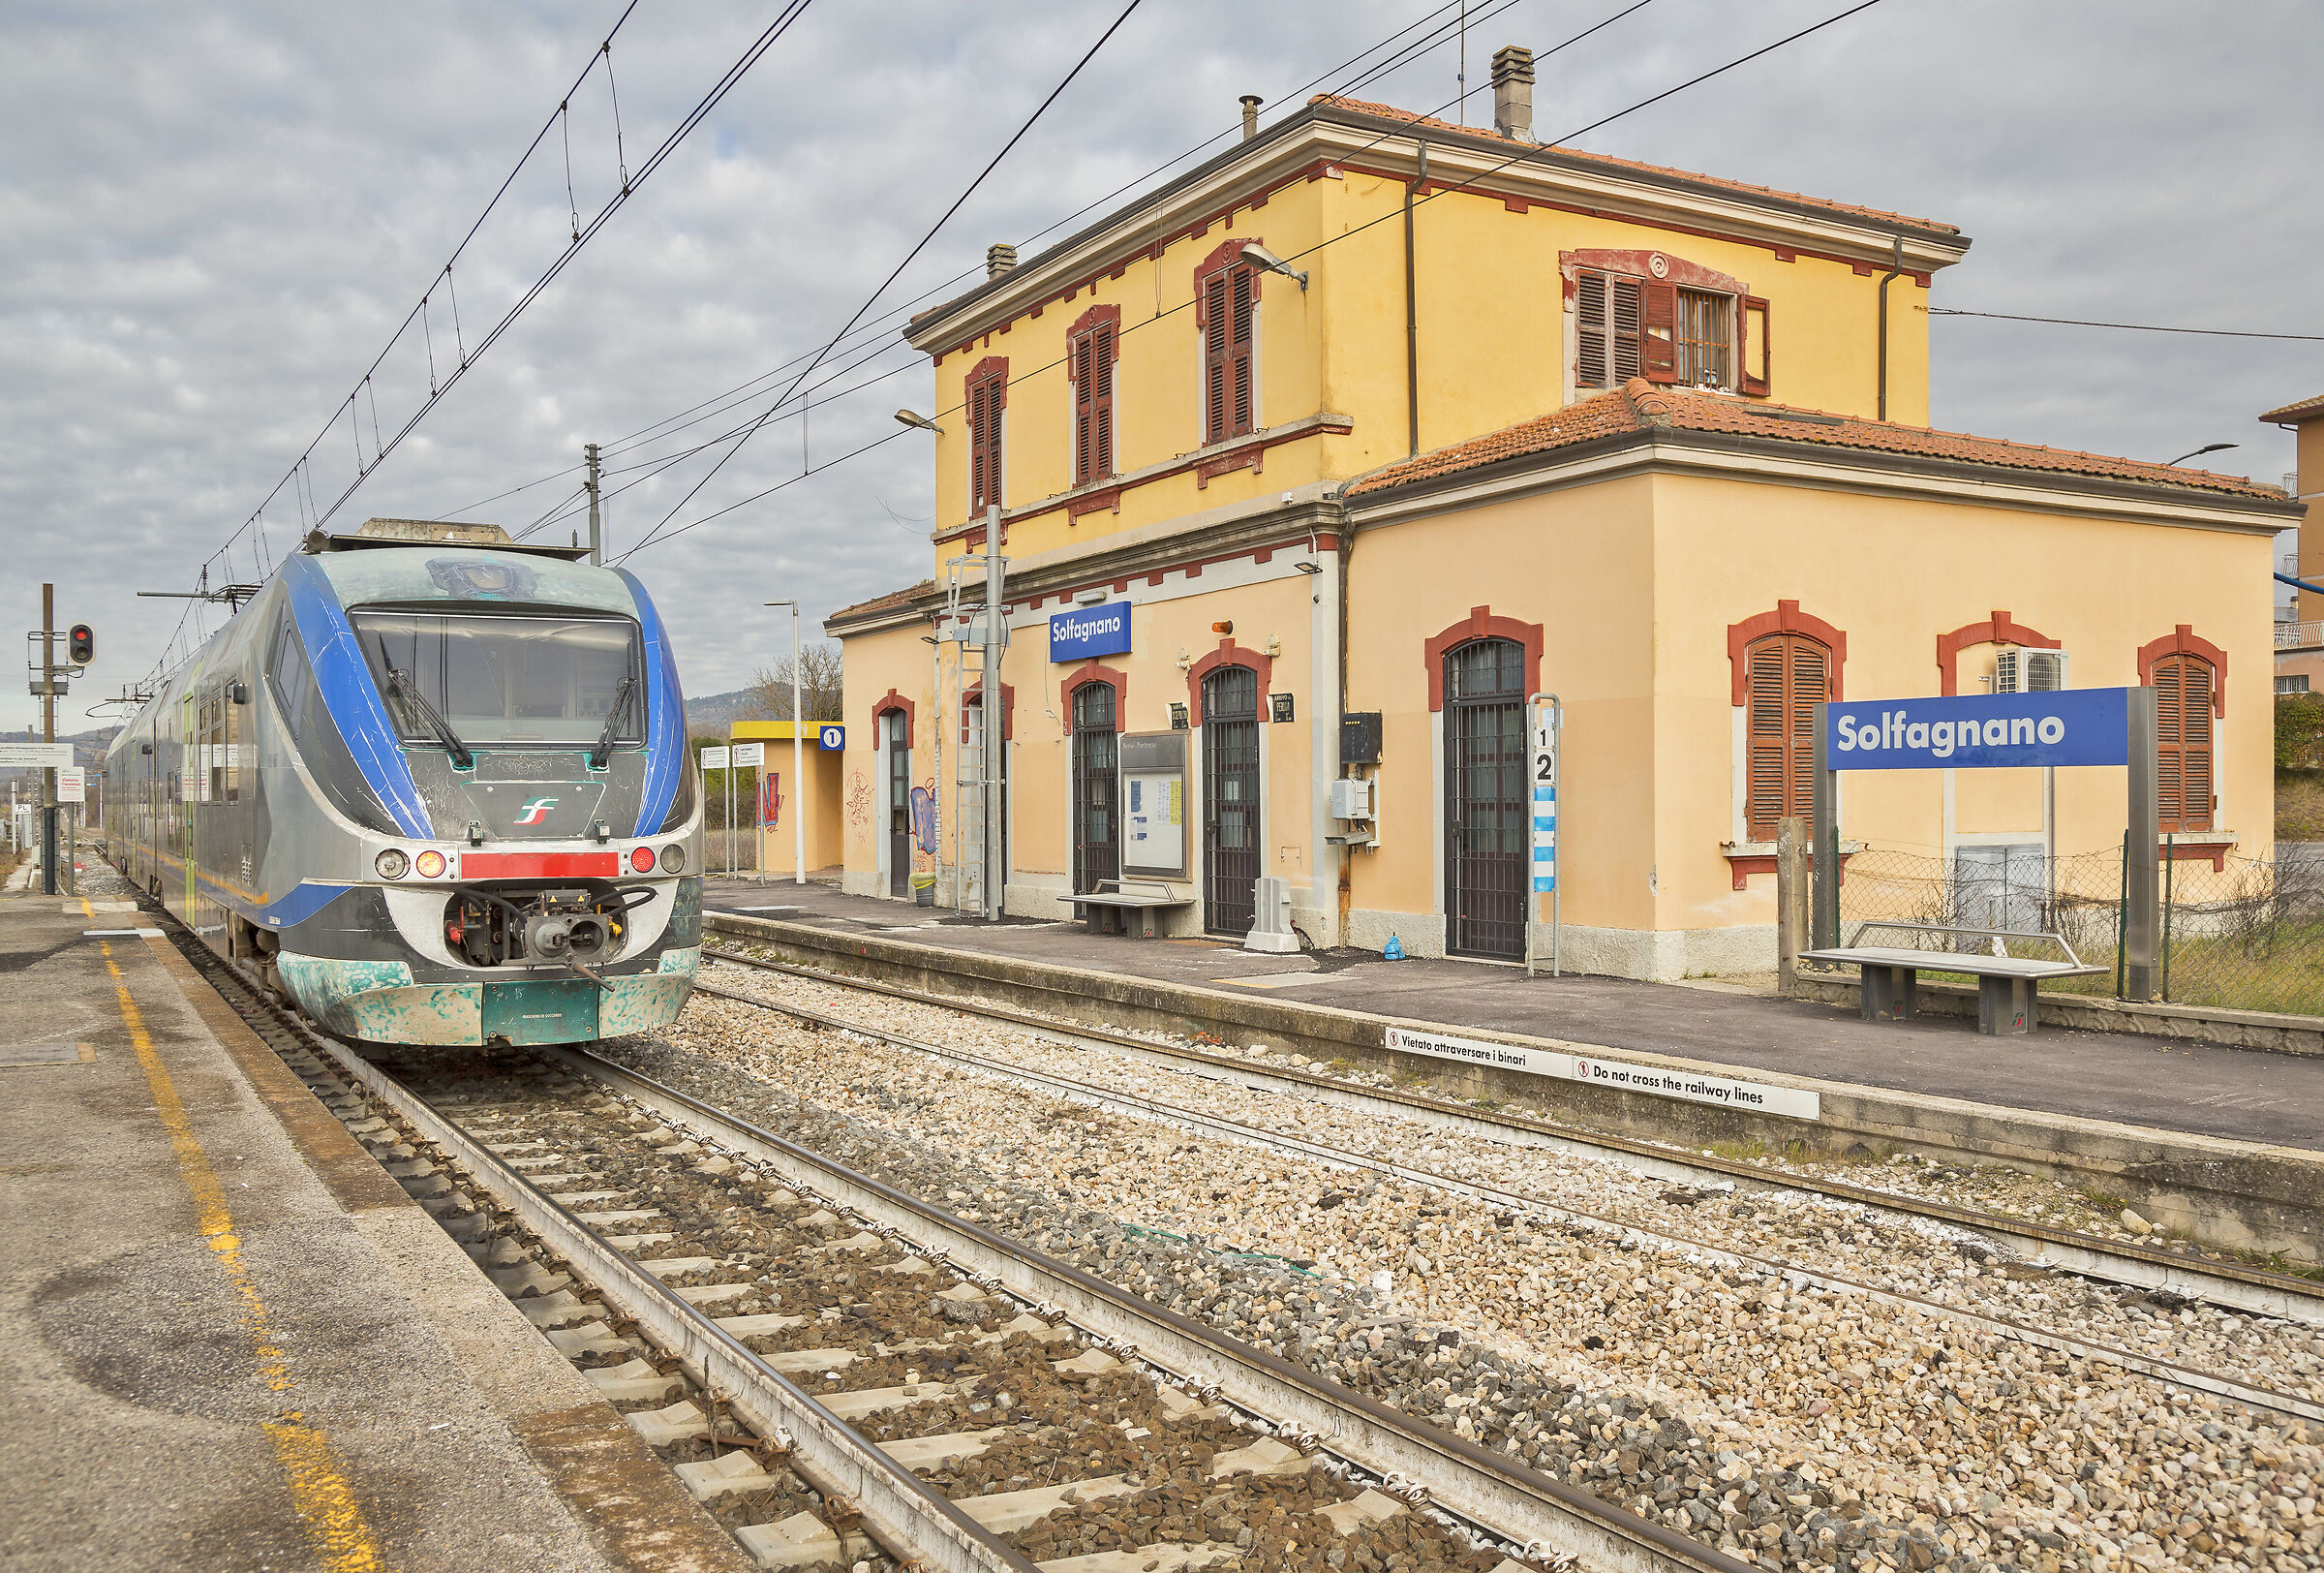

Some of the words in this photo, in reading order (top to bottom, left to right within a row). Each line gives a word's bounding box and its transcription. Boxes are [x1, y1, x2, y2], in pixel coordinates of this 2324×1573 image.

[1053, 616, 1121, 643] Solfagnano
[829, 731, 835, 744] 1
[1540, 729, 1546, 746] 1
[1837, 710, 2065, 757] Solfagnano
[1537, 755, 1551, 780] 2
[1401, 1034, 1432, 1051] Vietato
[1434, 1042, 1491, 1060] attraversare
[1498, 1050, 1526, 1065] binari
[1593, 1065, 1608, 1079] Do
[1612, 1070, 1630, 1083] not
[1632, 1075, 1660, 1088] cross
[1663, 1076, 1682, 1091] the
[1685, 1082, 1731, 1101] railway
[1734, 1086, 1763, 1104] lines
